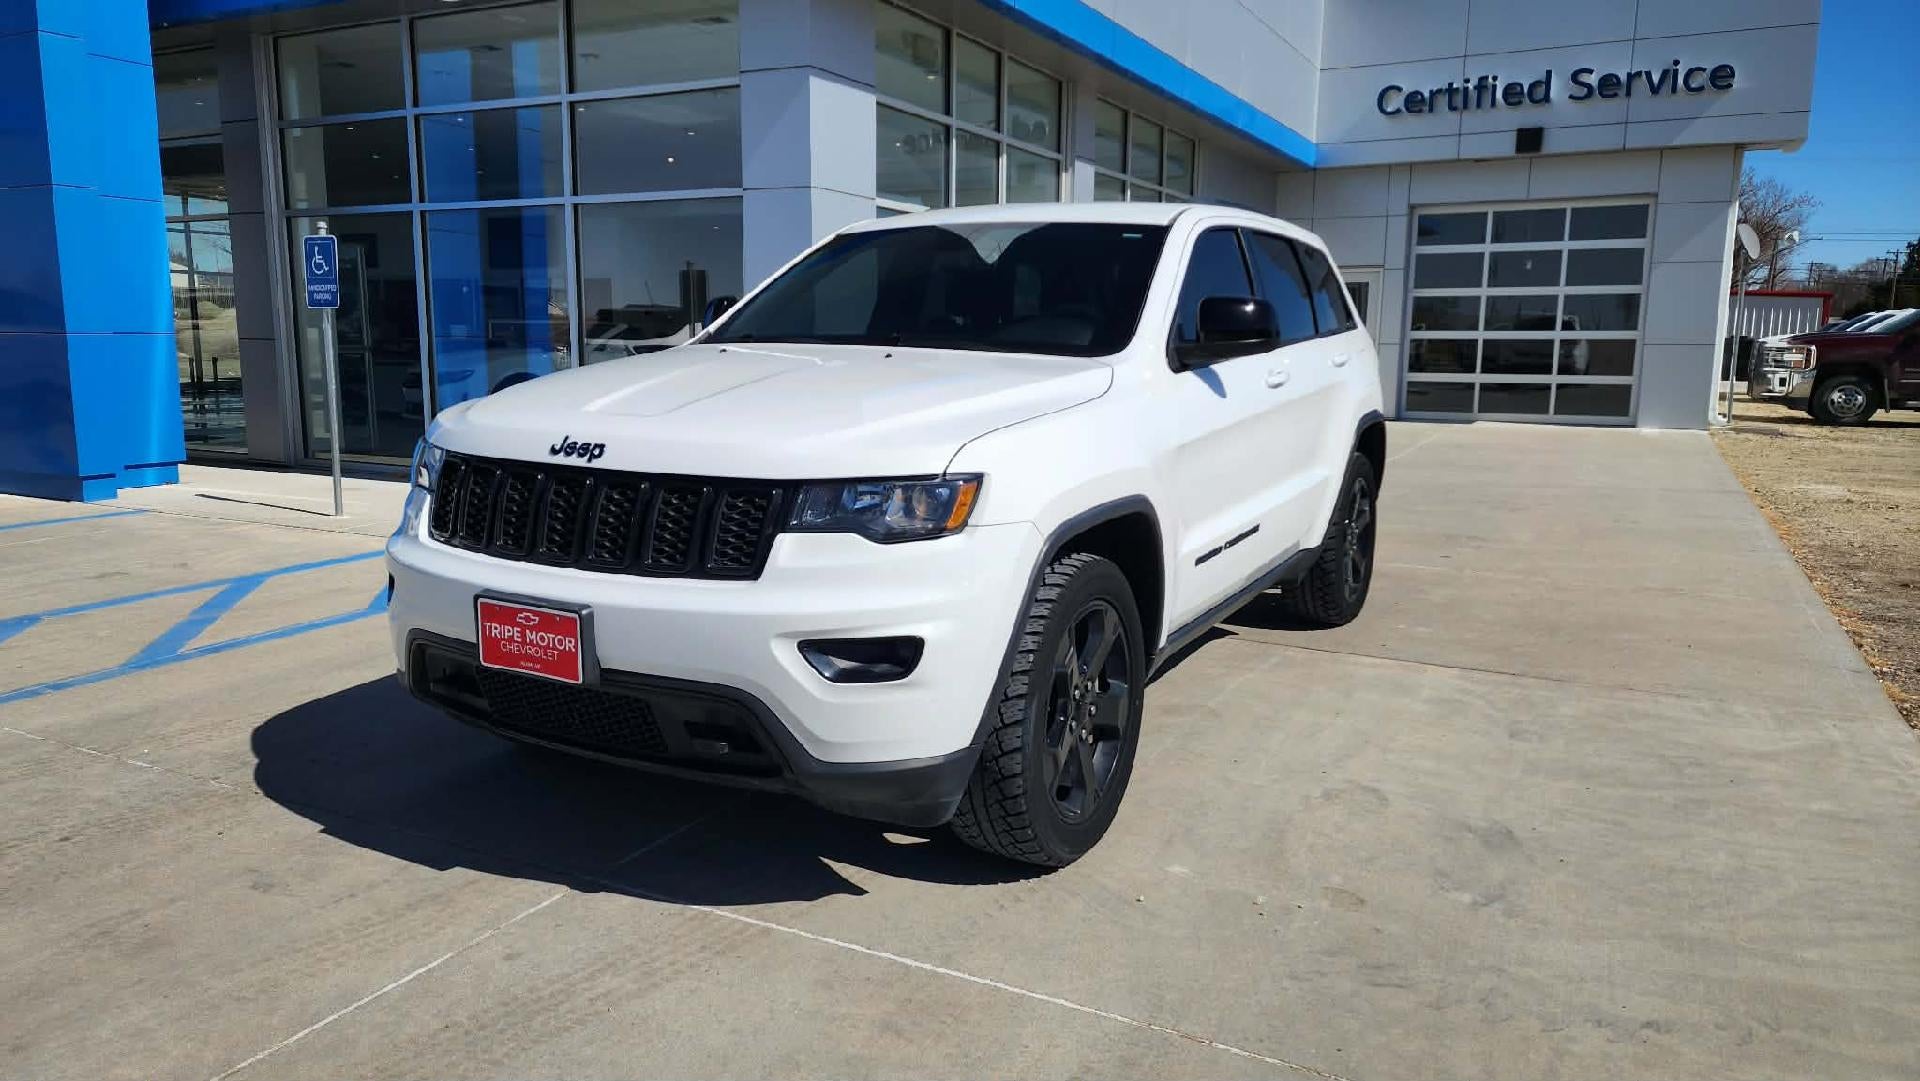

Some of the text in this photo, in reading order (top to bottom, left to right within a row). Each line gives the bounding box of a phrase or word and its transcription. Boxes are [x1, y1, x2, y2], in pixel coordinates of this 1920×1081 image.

[1377, 59, 1736, 116] Certified Service
[549, 435, 606, 463] Jeep
[483, 622, 576, 652] TRIPE MOTOR
[500, 640, 559, 661] CHEVROLET
